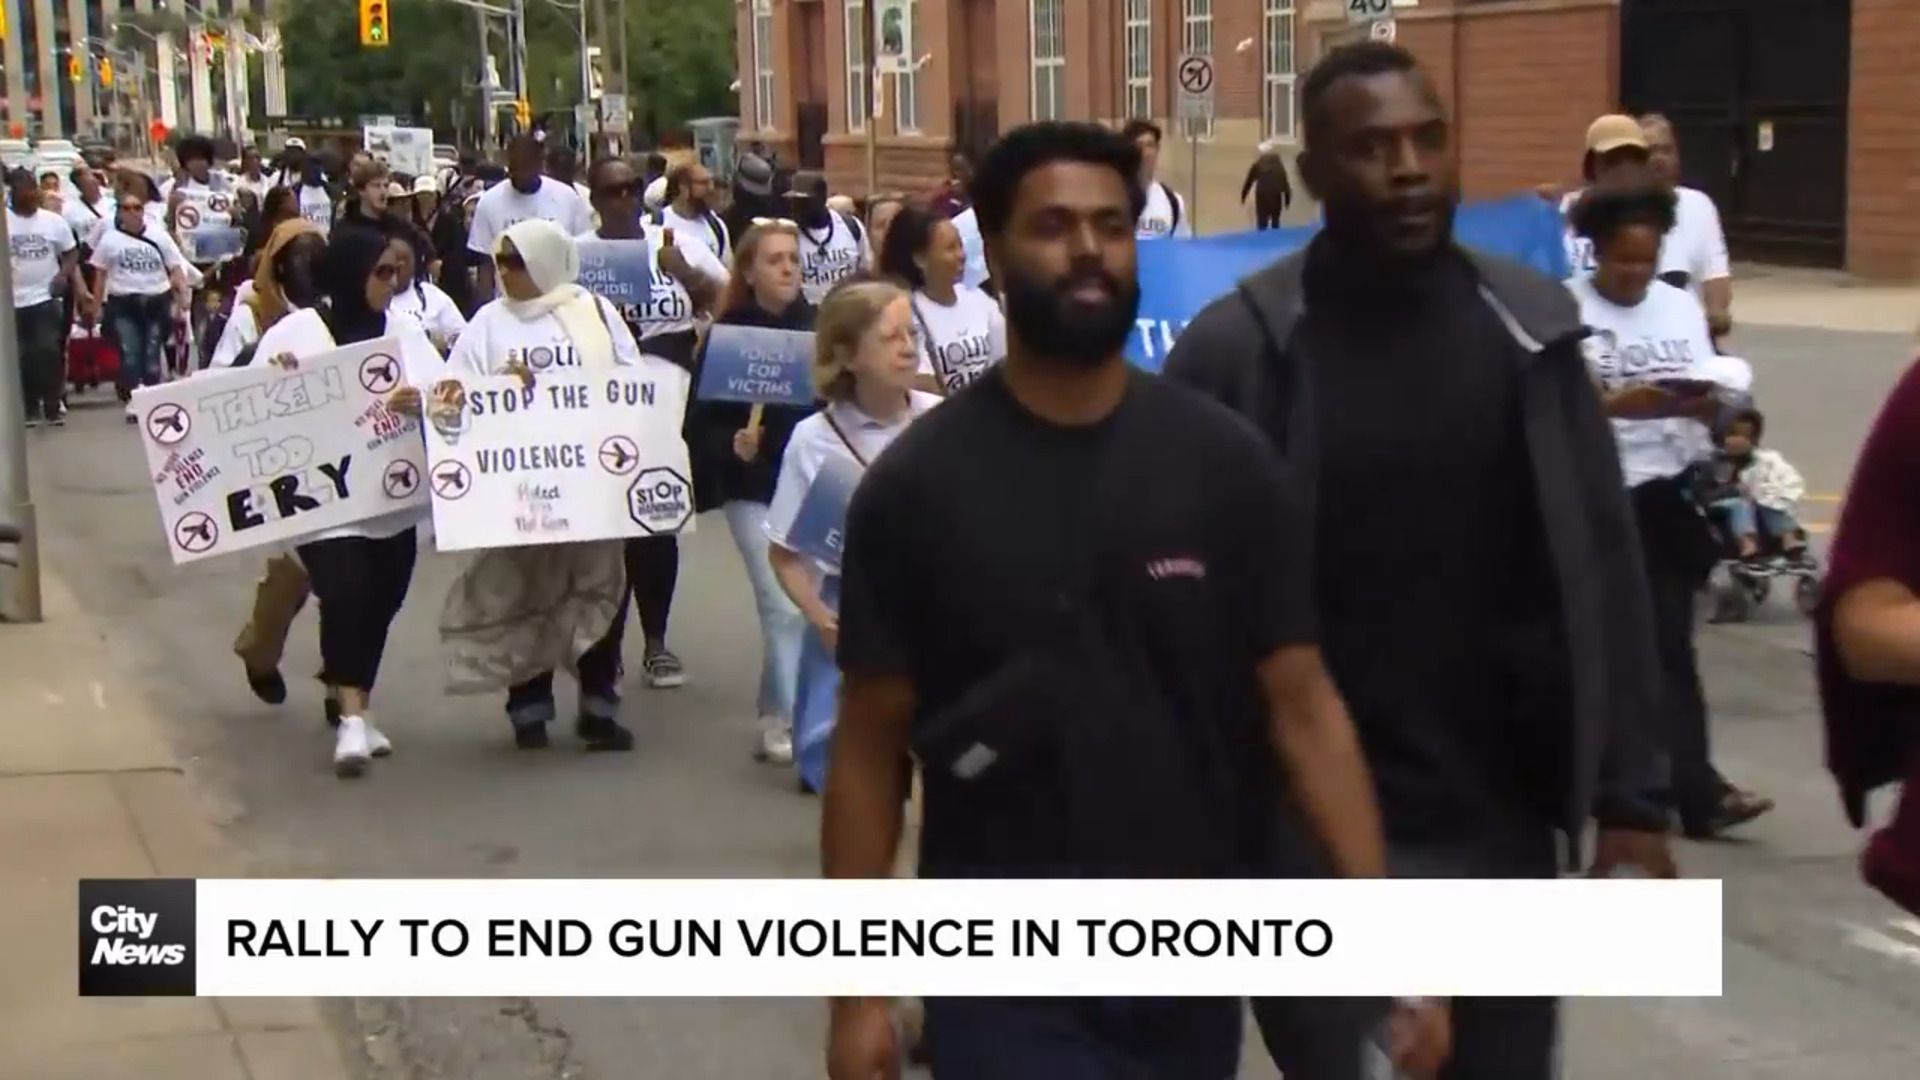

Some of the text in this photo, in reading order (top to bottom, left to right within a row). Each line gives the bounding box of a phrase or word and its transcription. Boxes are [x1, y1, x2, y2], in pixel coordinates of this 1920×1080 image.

[580, 269, 617, 282] ORE
[588, 282, 634, 295] ICIDE!
[746, 362, 782, 378] FOR
[470, 380, 656, 416] STOP THE GUN
[728, 376, 793, 396] VICTIMS
[199, 365, 346, 433] TAKEN
[373, 415, 400, 437] END
[233, 435, 314, 478] TOO
[476, 444, 587, 474] VIOLENCE
[174, 463, 204, 491] END
[636, 481, 684, 505] STOP
